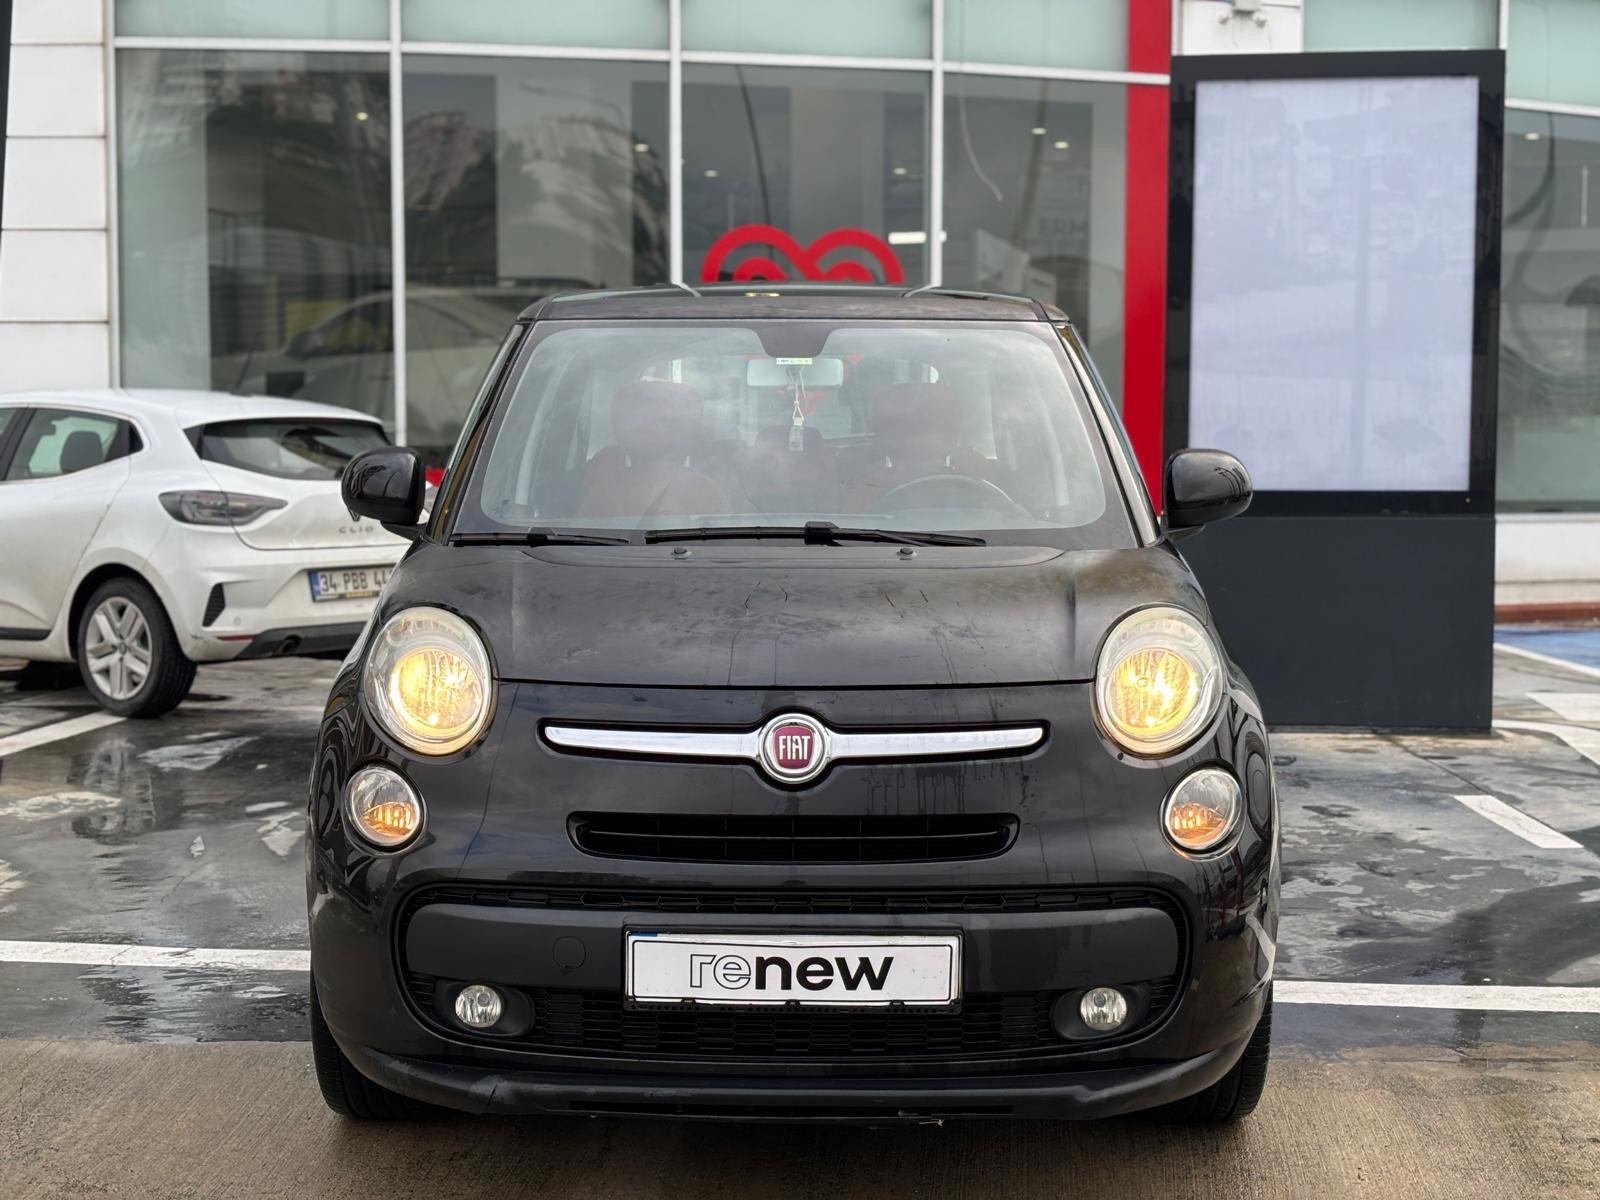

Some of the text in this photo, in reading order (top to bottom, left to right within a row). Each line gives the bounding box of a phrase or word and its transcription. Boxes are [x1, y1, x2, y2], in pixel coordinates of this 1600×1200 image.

[338, 526, 374, 534] CLIO
[320, 573, 337, 592] 34
[343, 572, 368, 590] PBB
[778, 735, 811, 760] FIAT
[690, 954, 894, 991] renew
